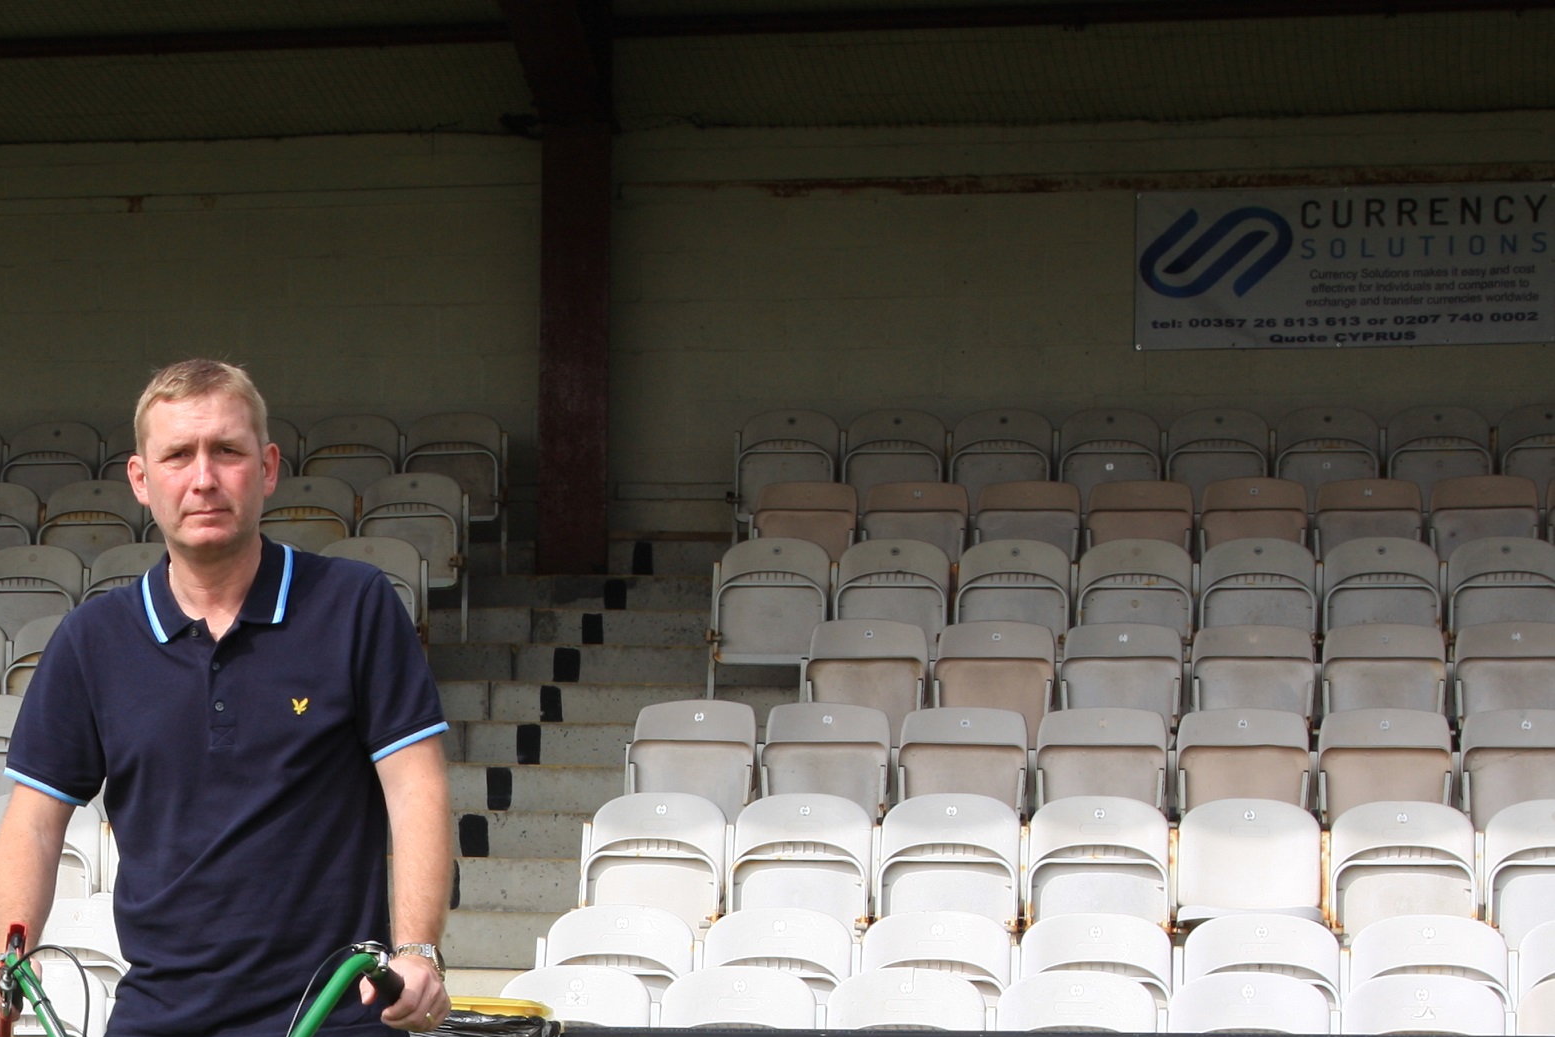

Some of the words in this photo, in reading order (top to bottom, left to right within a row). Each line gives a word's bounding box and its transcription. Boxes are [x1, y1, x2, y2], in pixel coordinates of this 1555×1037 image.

[1300, 194, 1548, 229] CURRENCY
[1300, 232, 1548, 259] SOLUTIONS
[1309, 269, 1358, 281] Currency
[1361, 268, 1410, 279] Solutions
[1413, 267, 1448, 277] makes
[1452, 267, 1458, 277] it
[1460, 268, 1486, 278] easy
[1489, 265, 1510, 276] and
[1513, 264, 1536, 275] cost
[1311, 283, 1356, 293] effective
[1358, 281, 1373, 292] for
[1375, 281, 1431, 292] individuals
[1434, 280, 1455, 290] and
[1458, 279, 1516, 292] companies
[1518, 278, 1530, 288] to
[1305, 296, 1357, 309] exchange
[1360, 295, 1380, 306] and
[1383, 295, 1424, 306] transfer
[1427, 293, 1482, 305] currencies
[1485, 291, 1539, 302] worldwide
[1151, 319, 1183, 330] tel:
[1189, 318, 1247, 329] 00357
[1254, 317, 1277, 328] 26
[1283, 317, 1319, 327] 813
[1324, 316, 1361, 327] 613
[1366, 316, 1388, 326] or
[1393, 314, 1441, 325] 0207
[1446, 312, 1483, 323] 740
[1489, 311, 1539, 322] 0002
[1268, 331, 1328, 343] Quote
[1334, 330, 1417, 342] CYPRUS
